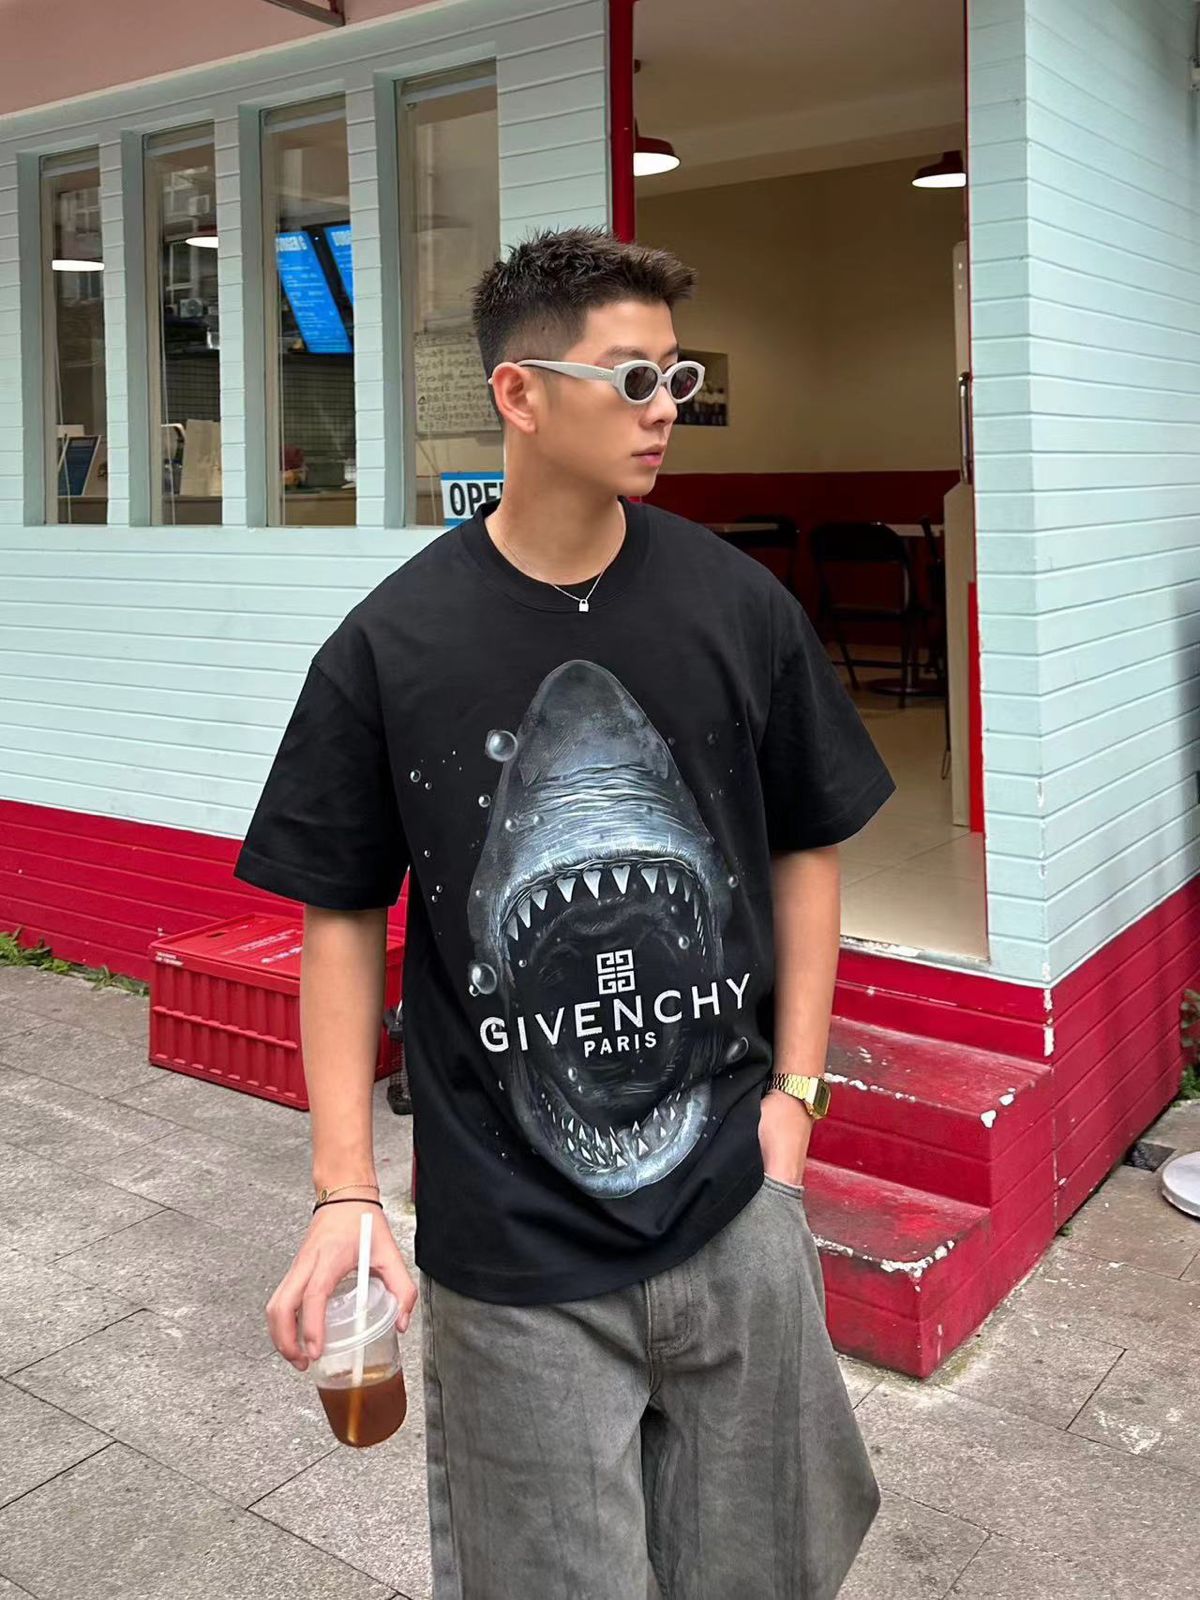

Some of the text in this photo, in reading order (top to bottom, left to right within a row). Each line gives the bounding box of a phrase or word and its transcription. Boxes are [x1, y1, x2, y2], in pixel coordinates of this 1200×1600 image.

[449, 482, 504, 516] OPE
[480, 973, 750, 1052] GIVENCHY
[584, 1031, 657, 1058] PARIS
